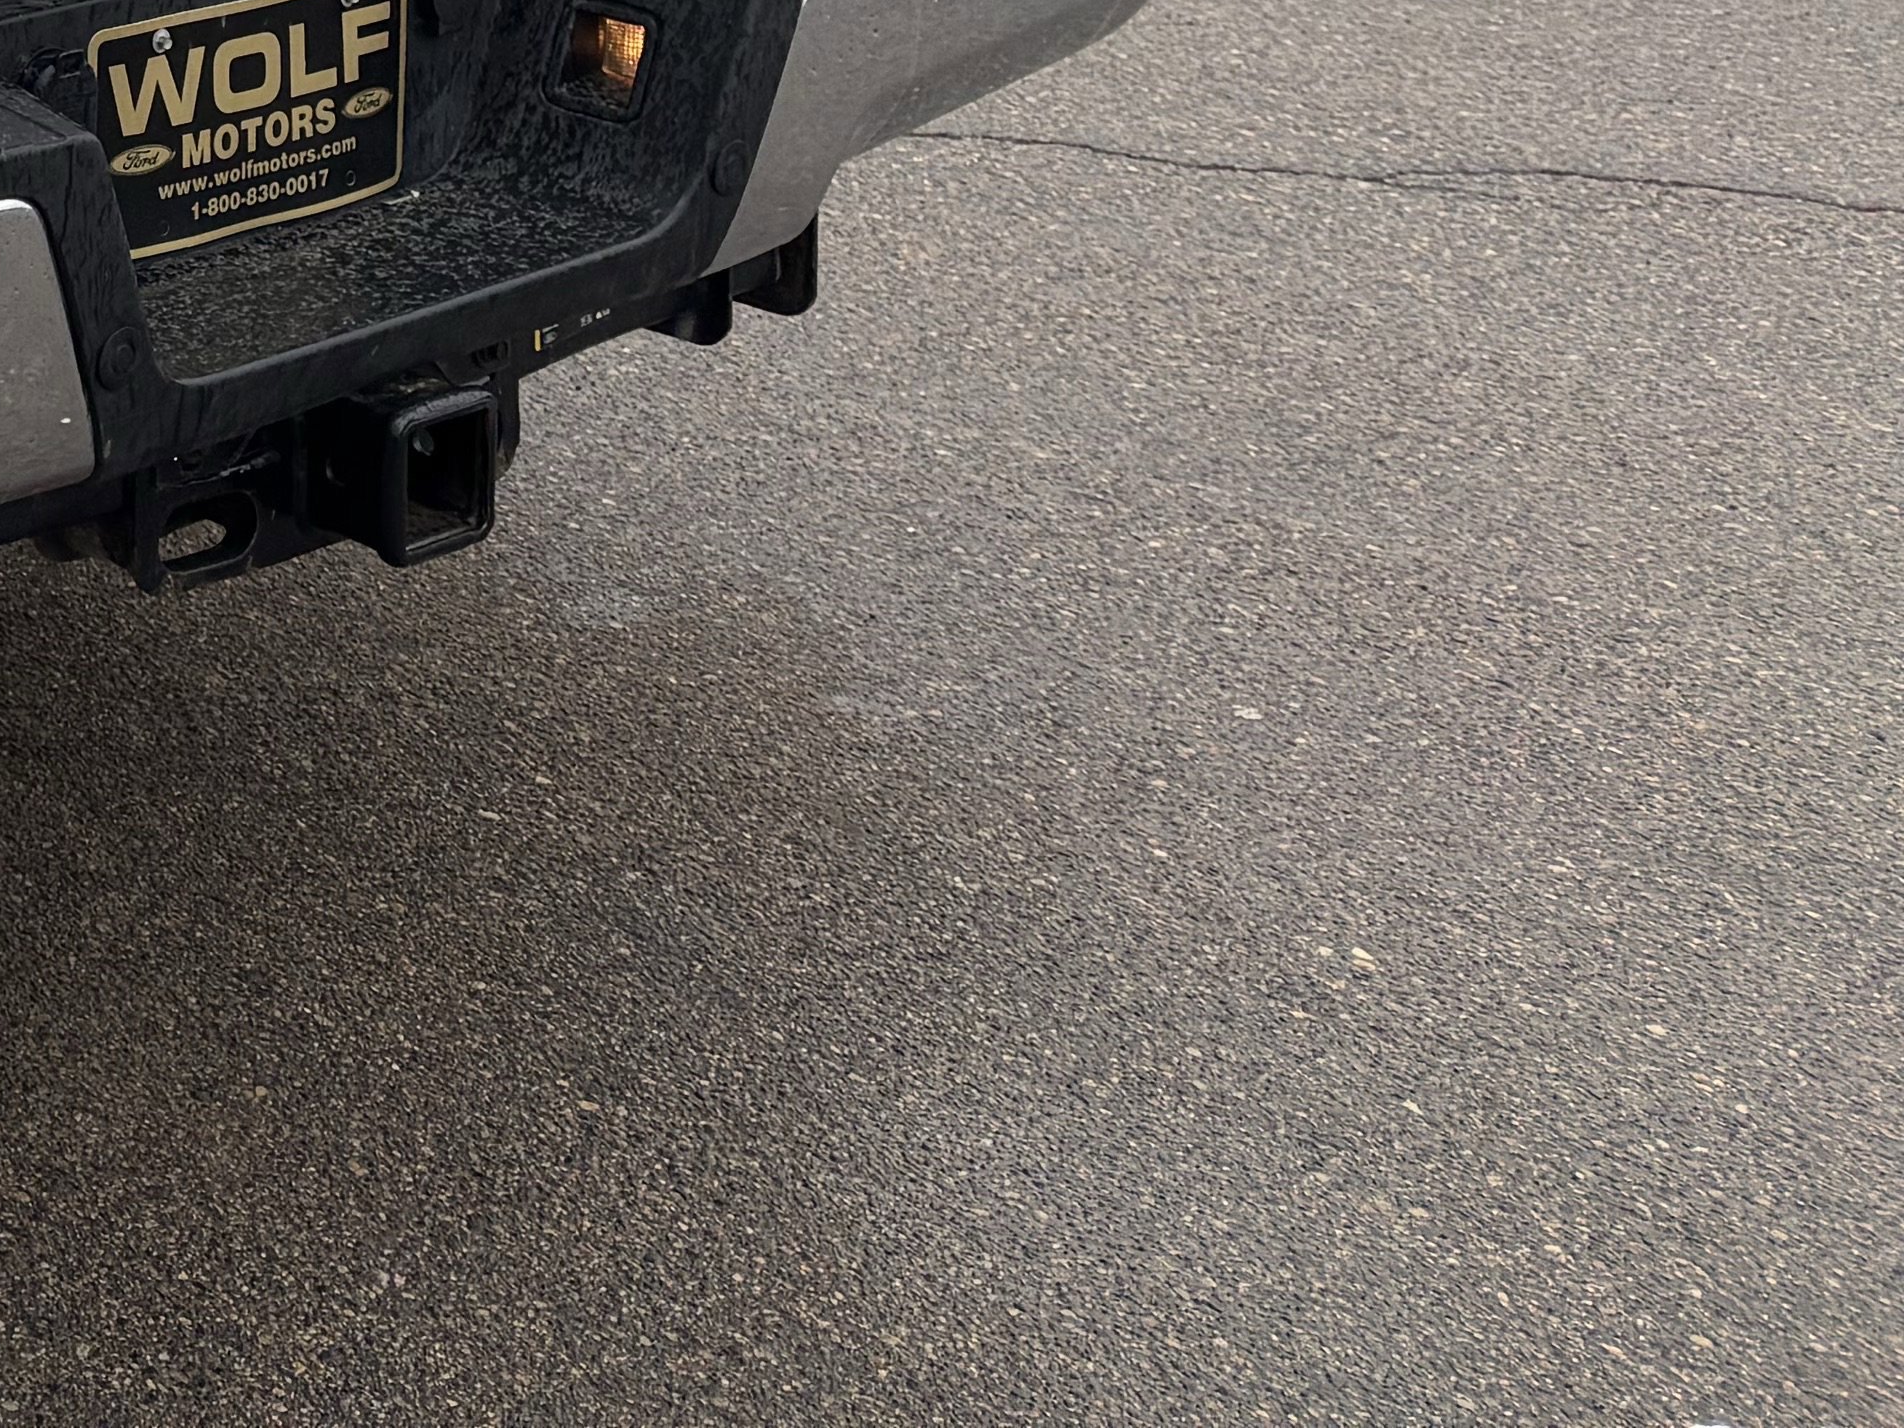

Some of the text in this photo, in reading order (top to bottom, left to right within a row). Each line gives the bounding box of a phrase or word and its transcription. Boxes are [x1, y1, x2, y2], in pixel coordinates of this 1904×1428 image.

[108, 0, 391, 137] WOLF
[181, 97, 336, 169] MOTORS
[353, 94, 382, 114] Ford
[122, 148, 159, 171] Ford
[158, 136, 357, 200] www.wolfmotors.com
[191, 169, 329, 221] 1-800-830-0017
